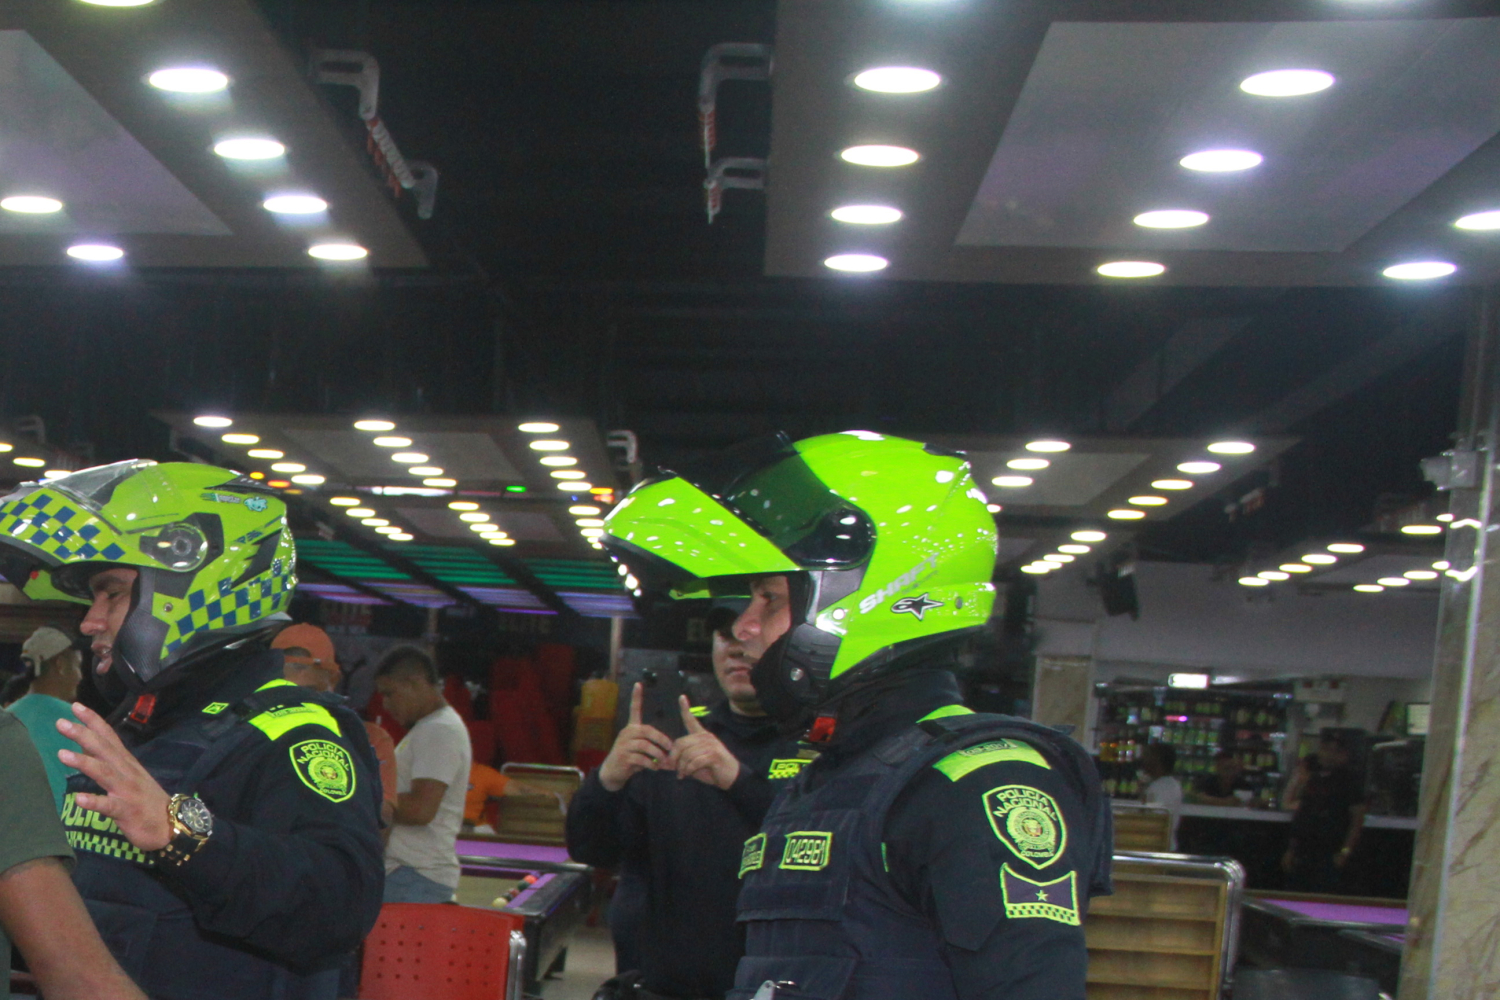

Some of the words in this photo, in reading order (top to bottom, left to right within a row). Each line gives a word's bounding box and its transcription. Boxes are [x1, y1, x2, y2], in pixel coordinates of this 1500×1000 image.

[859, 552, 940, 614] SHAFT
[297, 750, 349, 771] NACIONAL
[300, 743, 344, 758] POLICIA
[996, 788, 1049, 806] POLICIA
[992, 797, 1057, 821] NACIONAL
